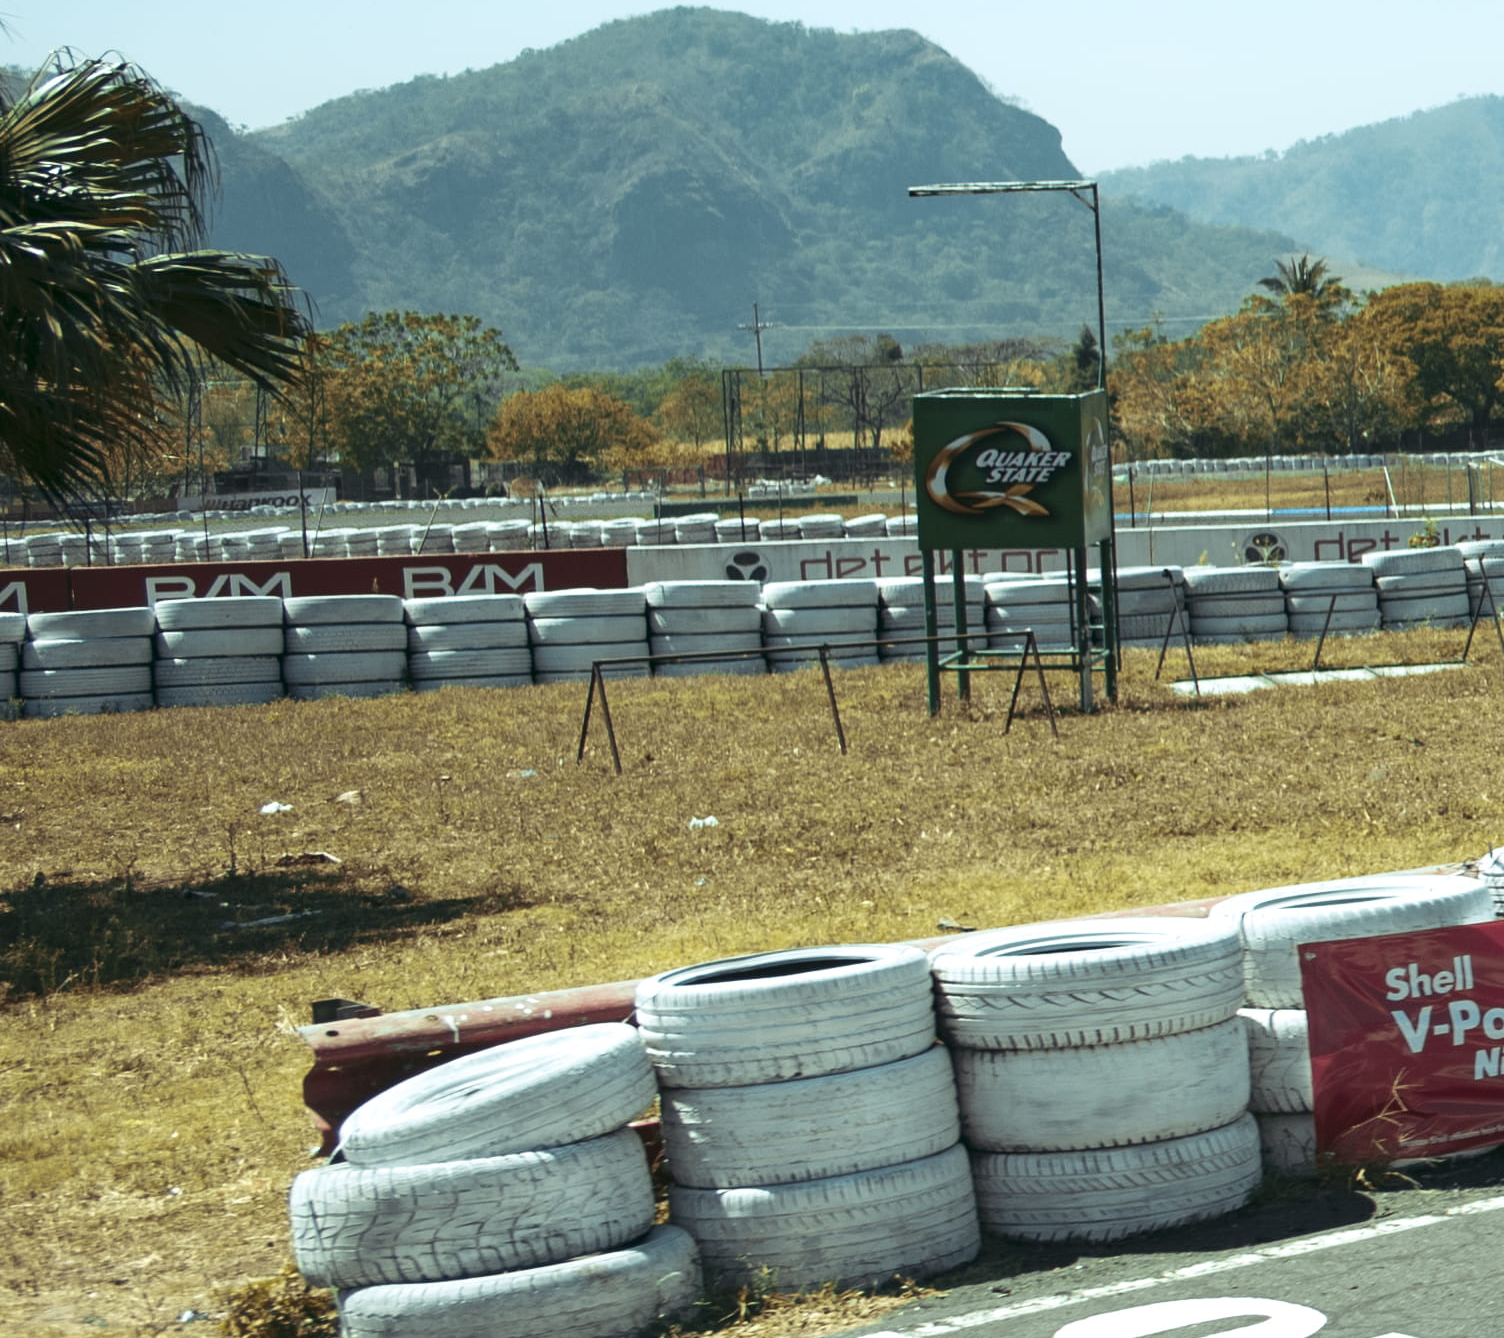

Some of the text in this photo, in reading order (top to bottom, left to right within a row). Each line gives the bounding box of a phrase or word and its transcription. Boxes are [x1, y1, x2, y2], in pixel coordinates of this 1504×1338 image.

[976, 448, 1072, 468] QUAKER
[985, 467, 1055, 483] STATE
[1385, 954, 1475, 1001] Shell
